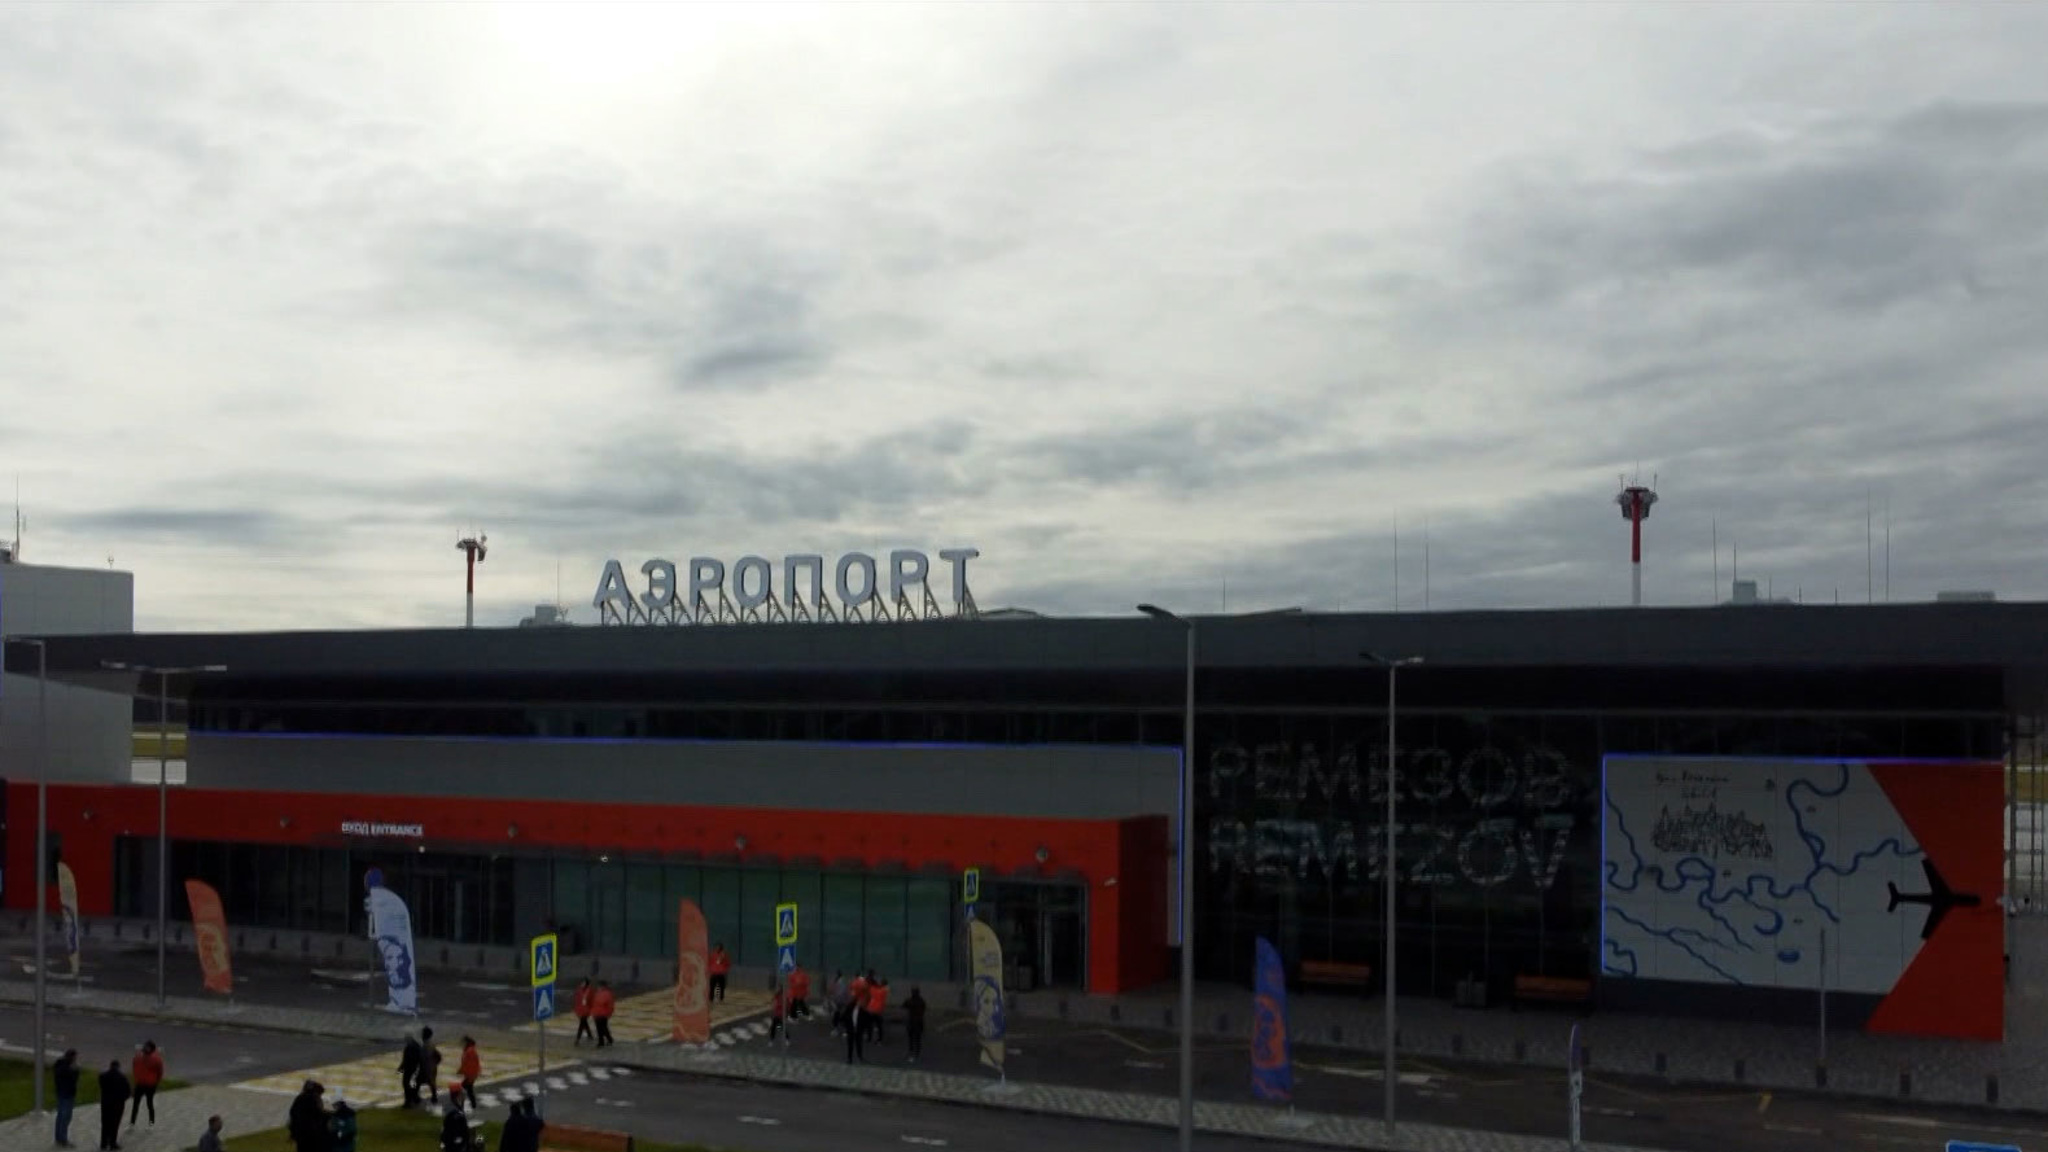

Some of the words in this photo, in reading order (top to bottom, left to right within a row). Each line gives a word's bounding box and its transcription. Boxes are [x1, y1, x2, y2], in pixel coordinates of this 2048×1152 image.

[593, 549, 979, 608] АЭРОПОРТ
[1210, 740, 1572, 807] РЕМЕЗОВ
[371, 824, 423, 836] ENTRANCE
[1210, 819, 1573, 888] REMEZOV
